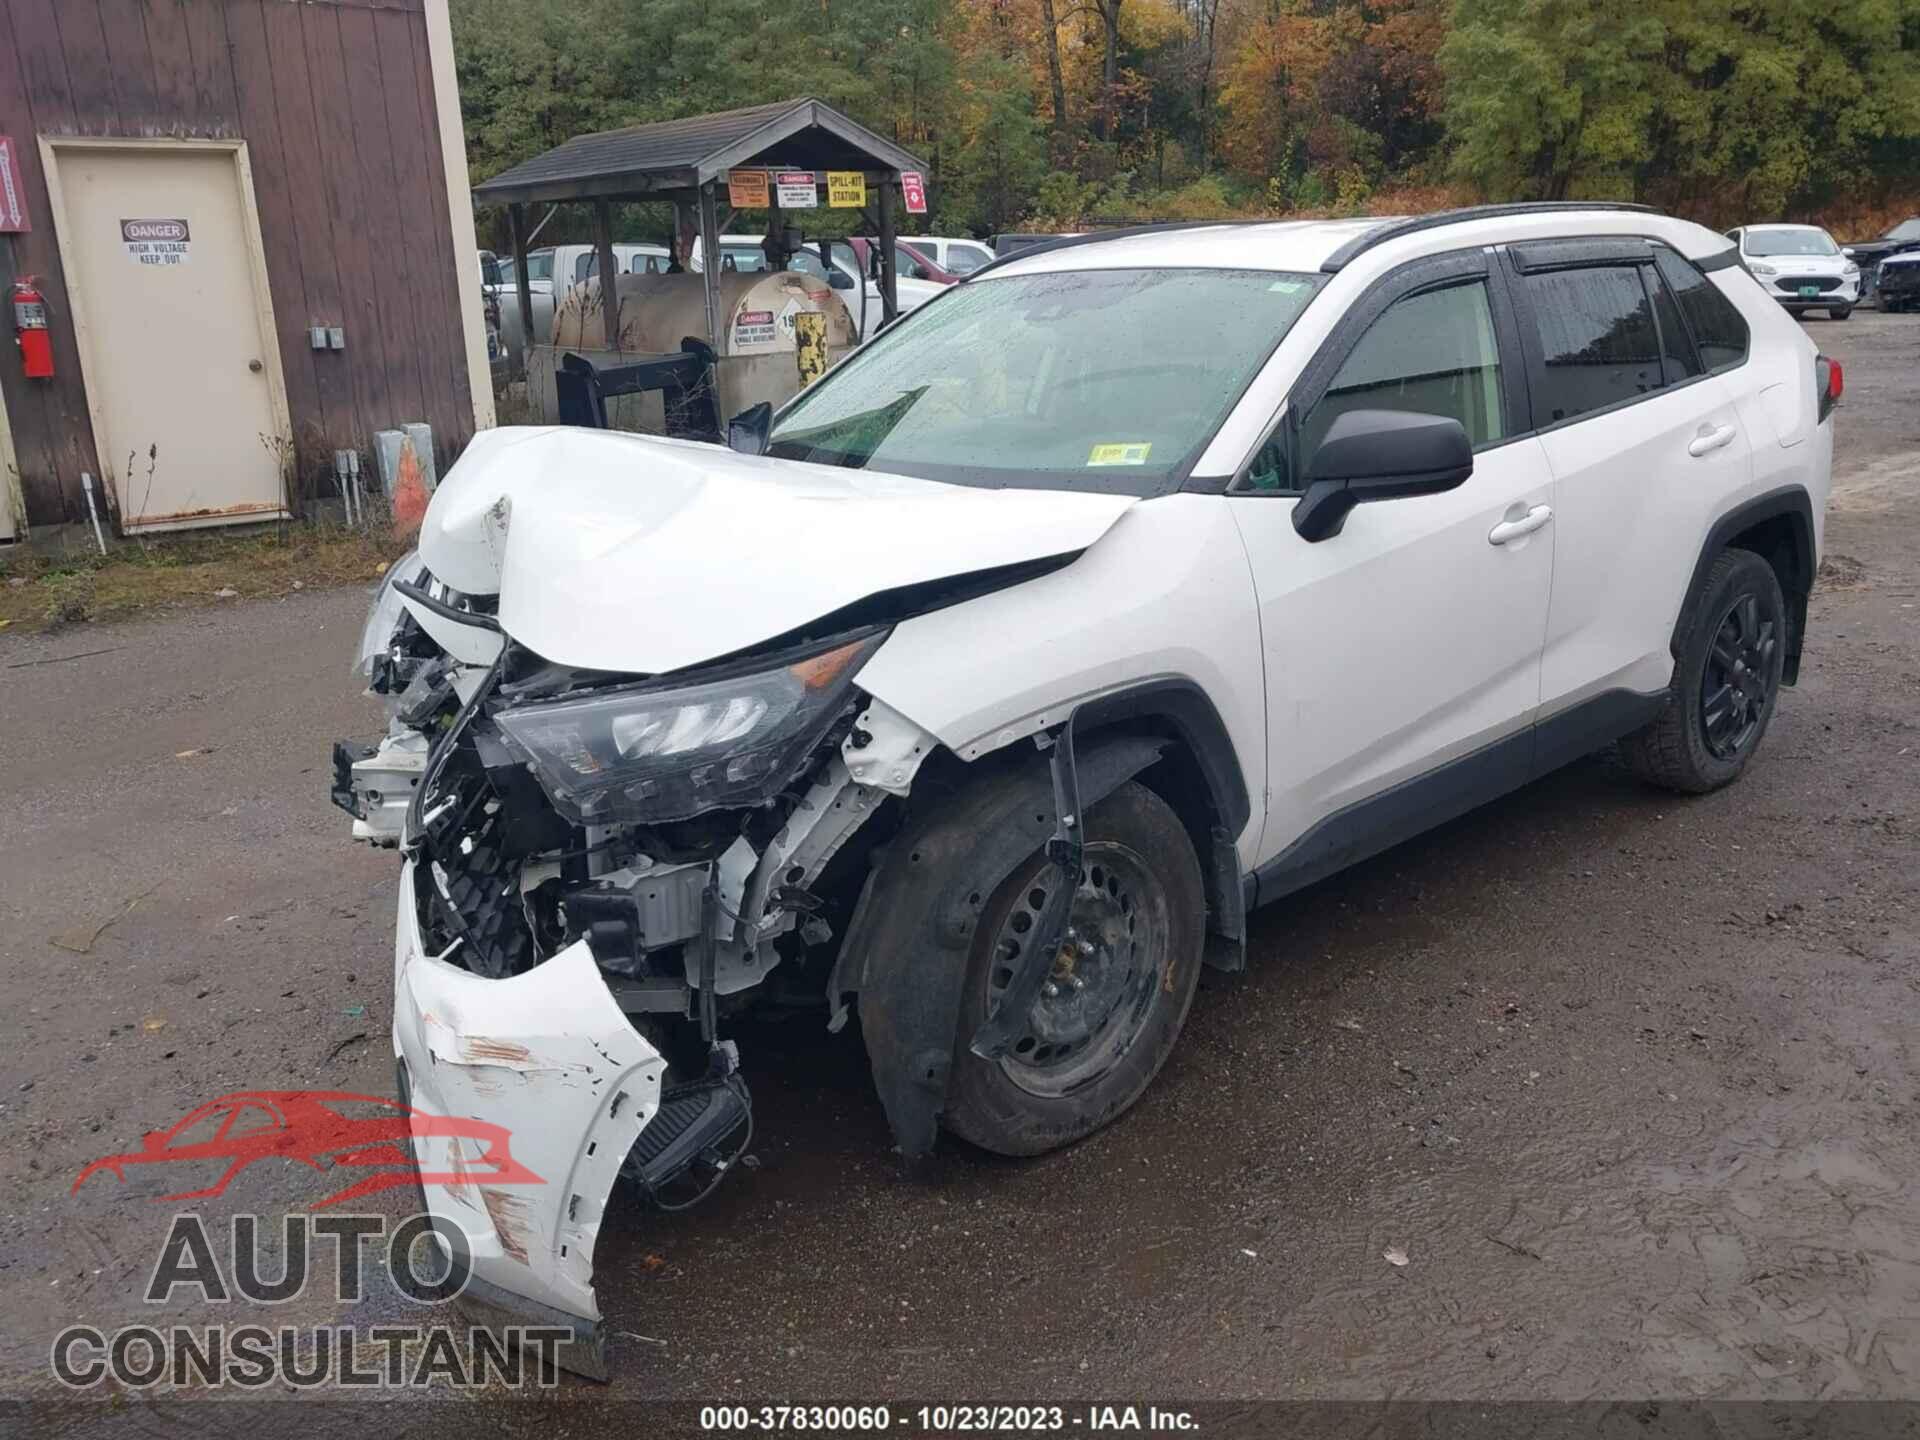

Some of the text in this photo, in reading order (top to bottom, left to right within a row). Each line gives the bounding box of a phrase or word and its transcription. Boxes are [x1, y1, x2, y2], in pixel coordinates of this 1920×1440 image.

[830, 175, 862, 187] SPILL-KIT
[832, 191, 860, 202] STATION
[130, 225, 180, 237] DANGER
[128, 243, 187, 253] HIGH VOLTAGE
[140, 254, 180, 264] KEEP OUT
[782, 314, 795, 328] 19
